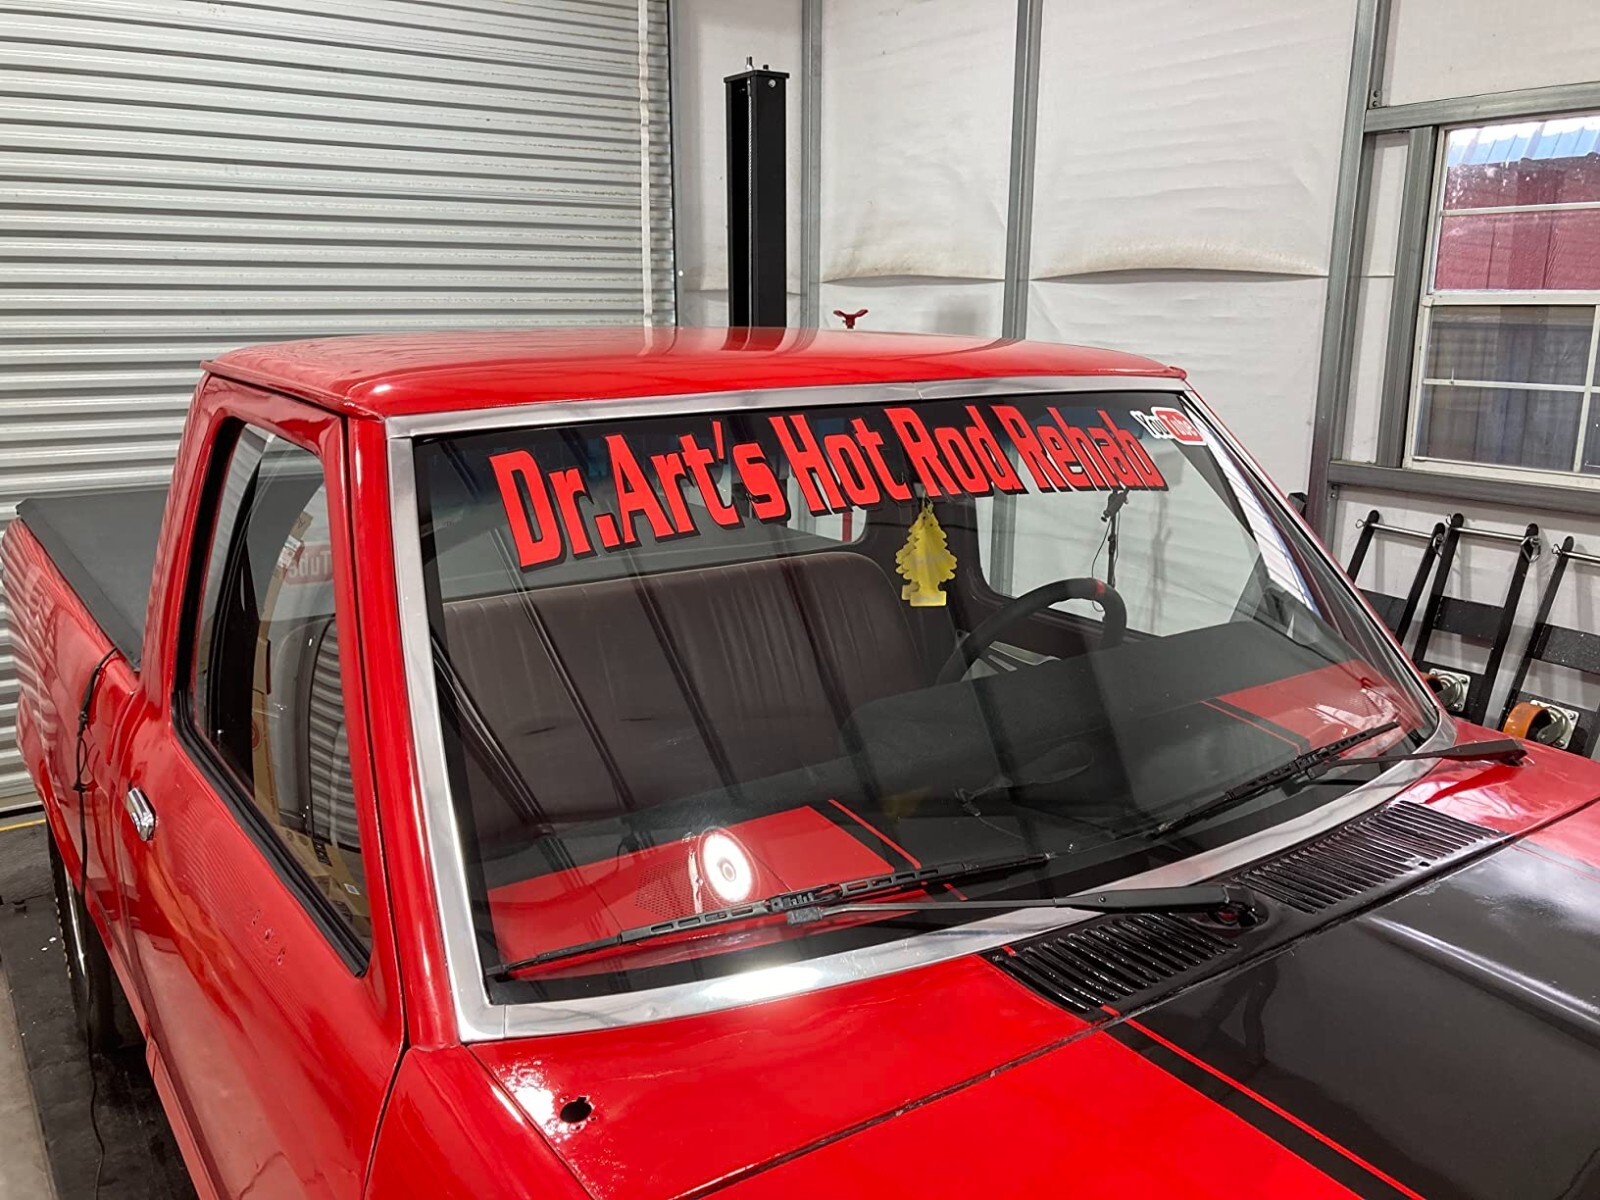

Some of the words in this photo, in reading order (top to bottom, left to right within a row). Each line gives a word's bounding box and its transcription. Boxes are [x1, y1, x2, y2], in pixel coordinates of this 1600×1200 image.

[768, 413, 912, 515] Hot
[884, 405, 1028, 497] Rod
[990, 405, 1168, 492] Rehab
